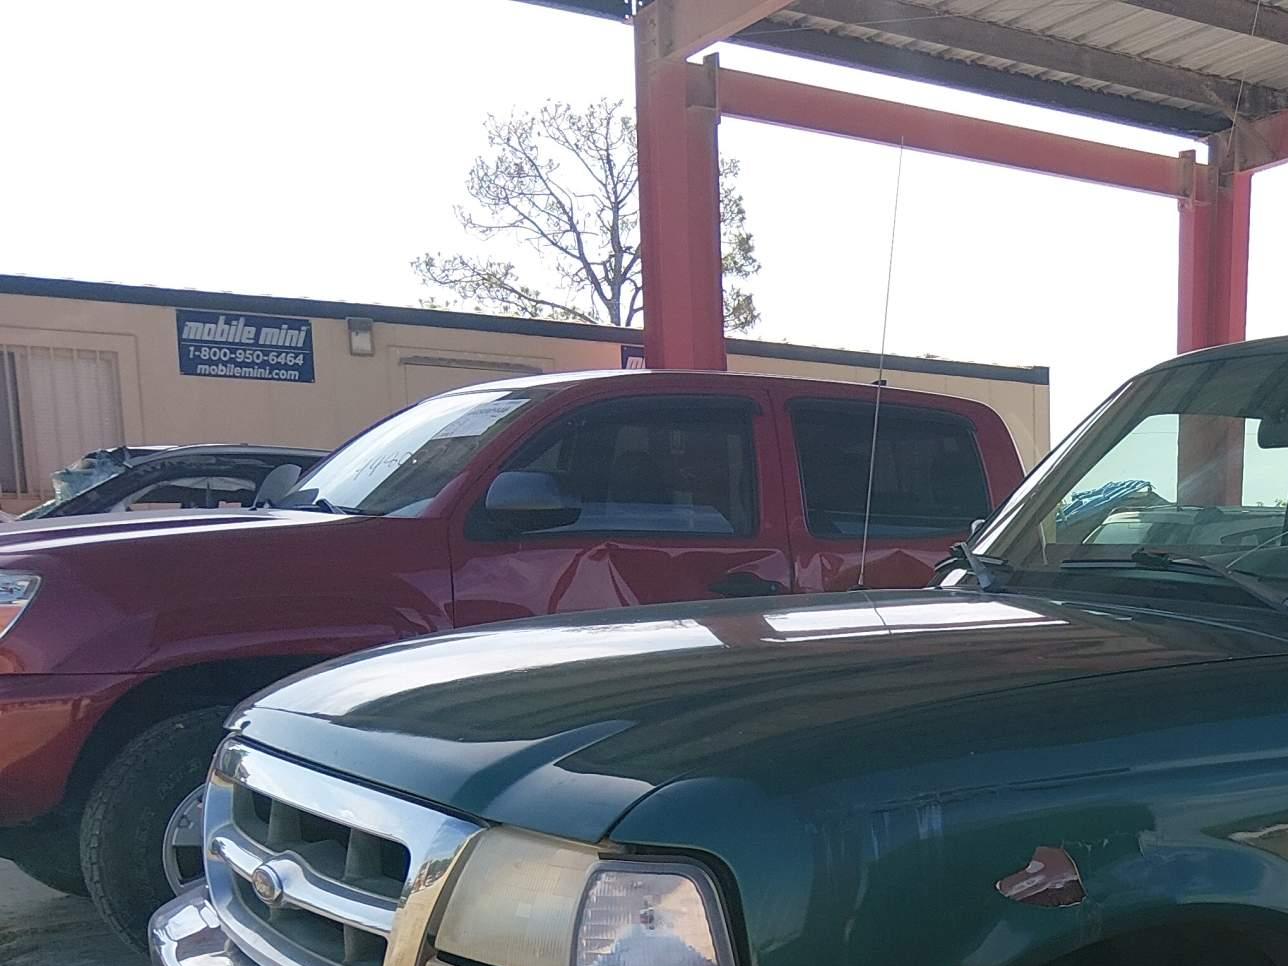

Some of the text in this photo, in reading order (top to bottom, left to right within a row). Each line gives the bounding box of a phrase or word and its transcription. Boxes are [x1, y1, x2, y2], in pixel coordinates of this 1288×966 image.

[182, 315, 308, 347] mobile mini
[189, 346, 304, 366] 1-800-950-6464
[196, 363, 300, 380] mobilemini.com
